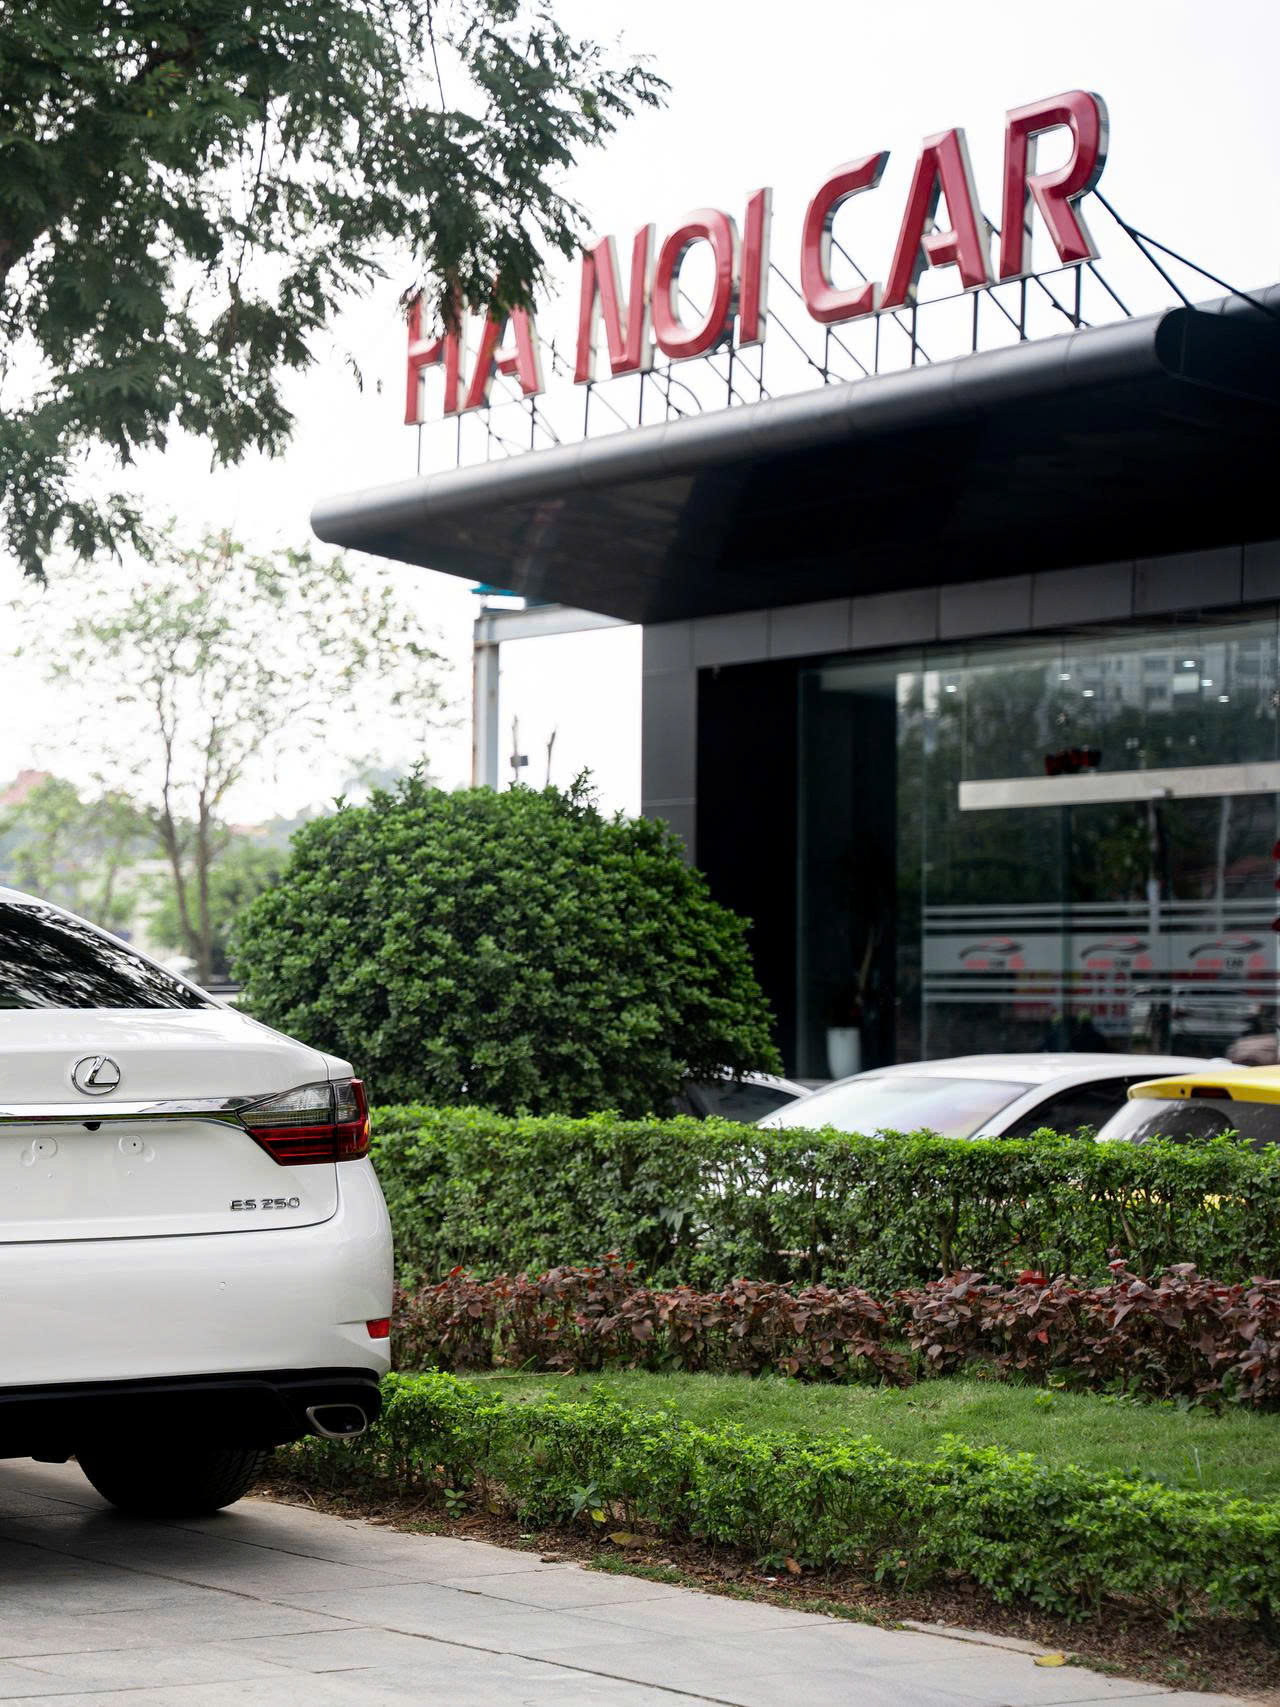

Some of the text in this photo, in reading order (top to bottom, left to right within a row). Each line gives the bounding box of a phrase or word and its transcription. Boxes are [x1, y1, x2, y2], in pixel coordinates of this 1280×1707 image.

[404, 89, 1110, 426] HA NOI CAR
[230, 1197, 300, 1211] ES 250
